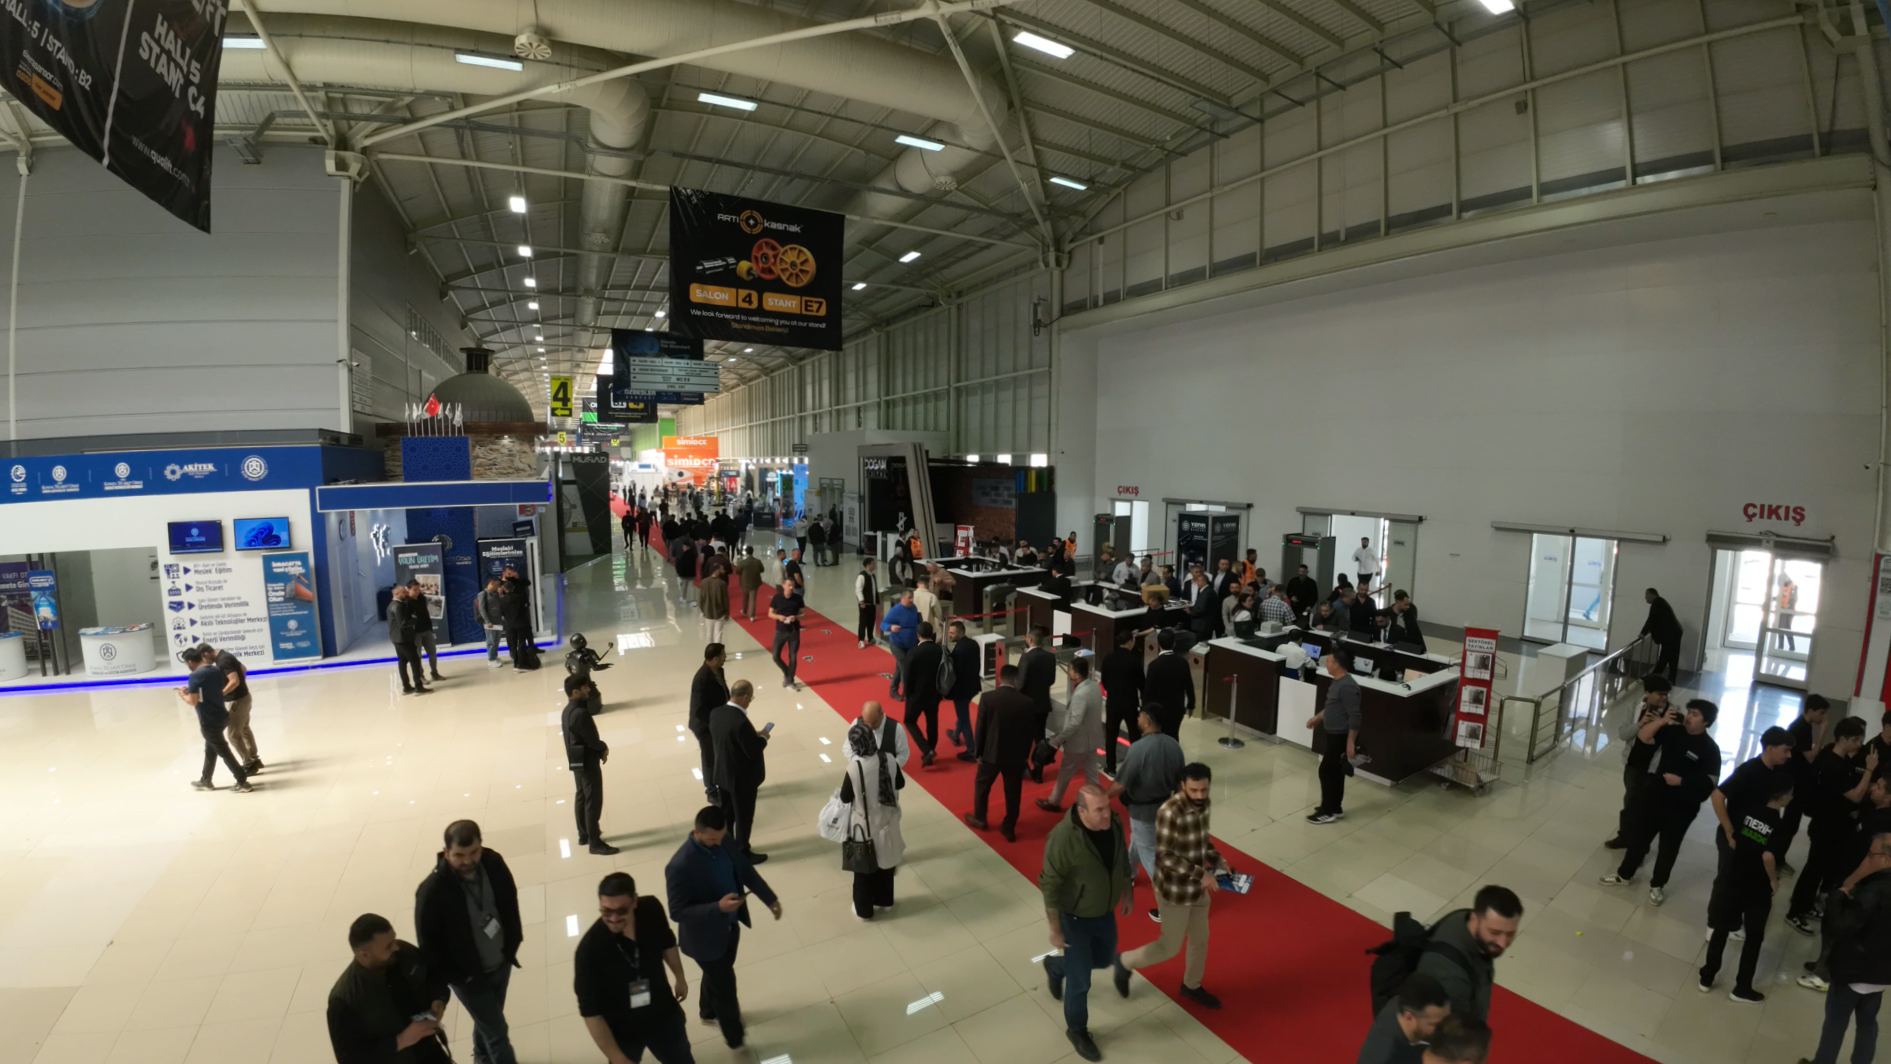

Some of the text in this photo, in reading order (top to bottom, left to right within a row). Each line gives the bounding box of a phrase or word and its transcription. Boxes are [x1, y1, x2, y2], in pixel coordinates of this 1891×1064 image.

[139, 31, 206, 120] STANT C4
[189, 59, 201, 84] 5
[763, 218, 802, 233] kasnak
[696, 289, 824, 314] SALON 4 STANT E7
[690, 308, 702, 316] We
[702, 309, 715, 318] look
[715, 311, 740, 320] forward
[748, 314, 779, 326] welcoming
[779, 318, 791, 327] you
[552, 381, 571, 407] 4
[559, 433, 565, 443] 5
[1117, 485, 1140, 496] ÇIKIŞ
[1743, 502, 1806, 526] ÇIKIŞ
[198, 603, 223, 611] Üretimde
[214, 618, 245, 627] Teknolojiler
[246, 616, 268, 624] Merkezi
[243, 650, 265, 658] Merkezi
